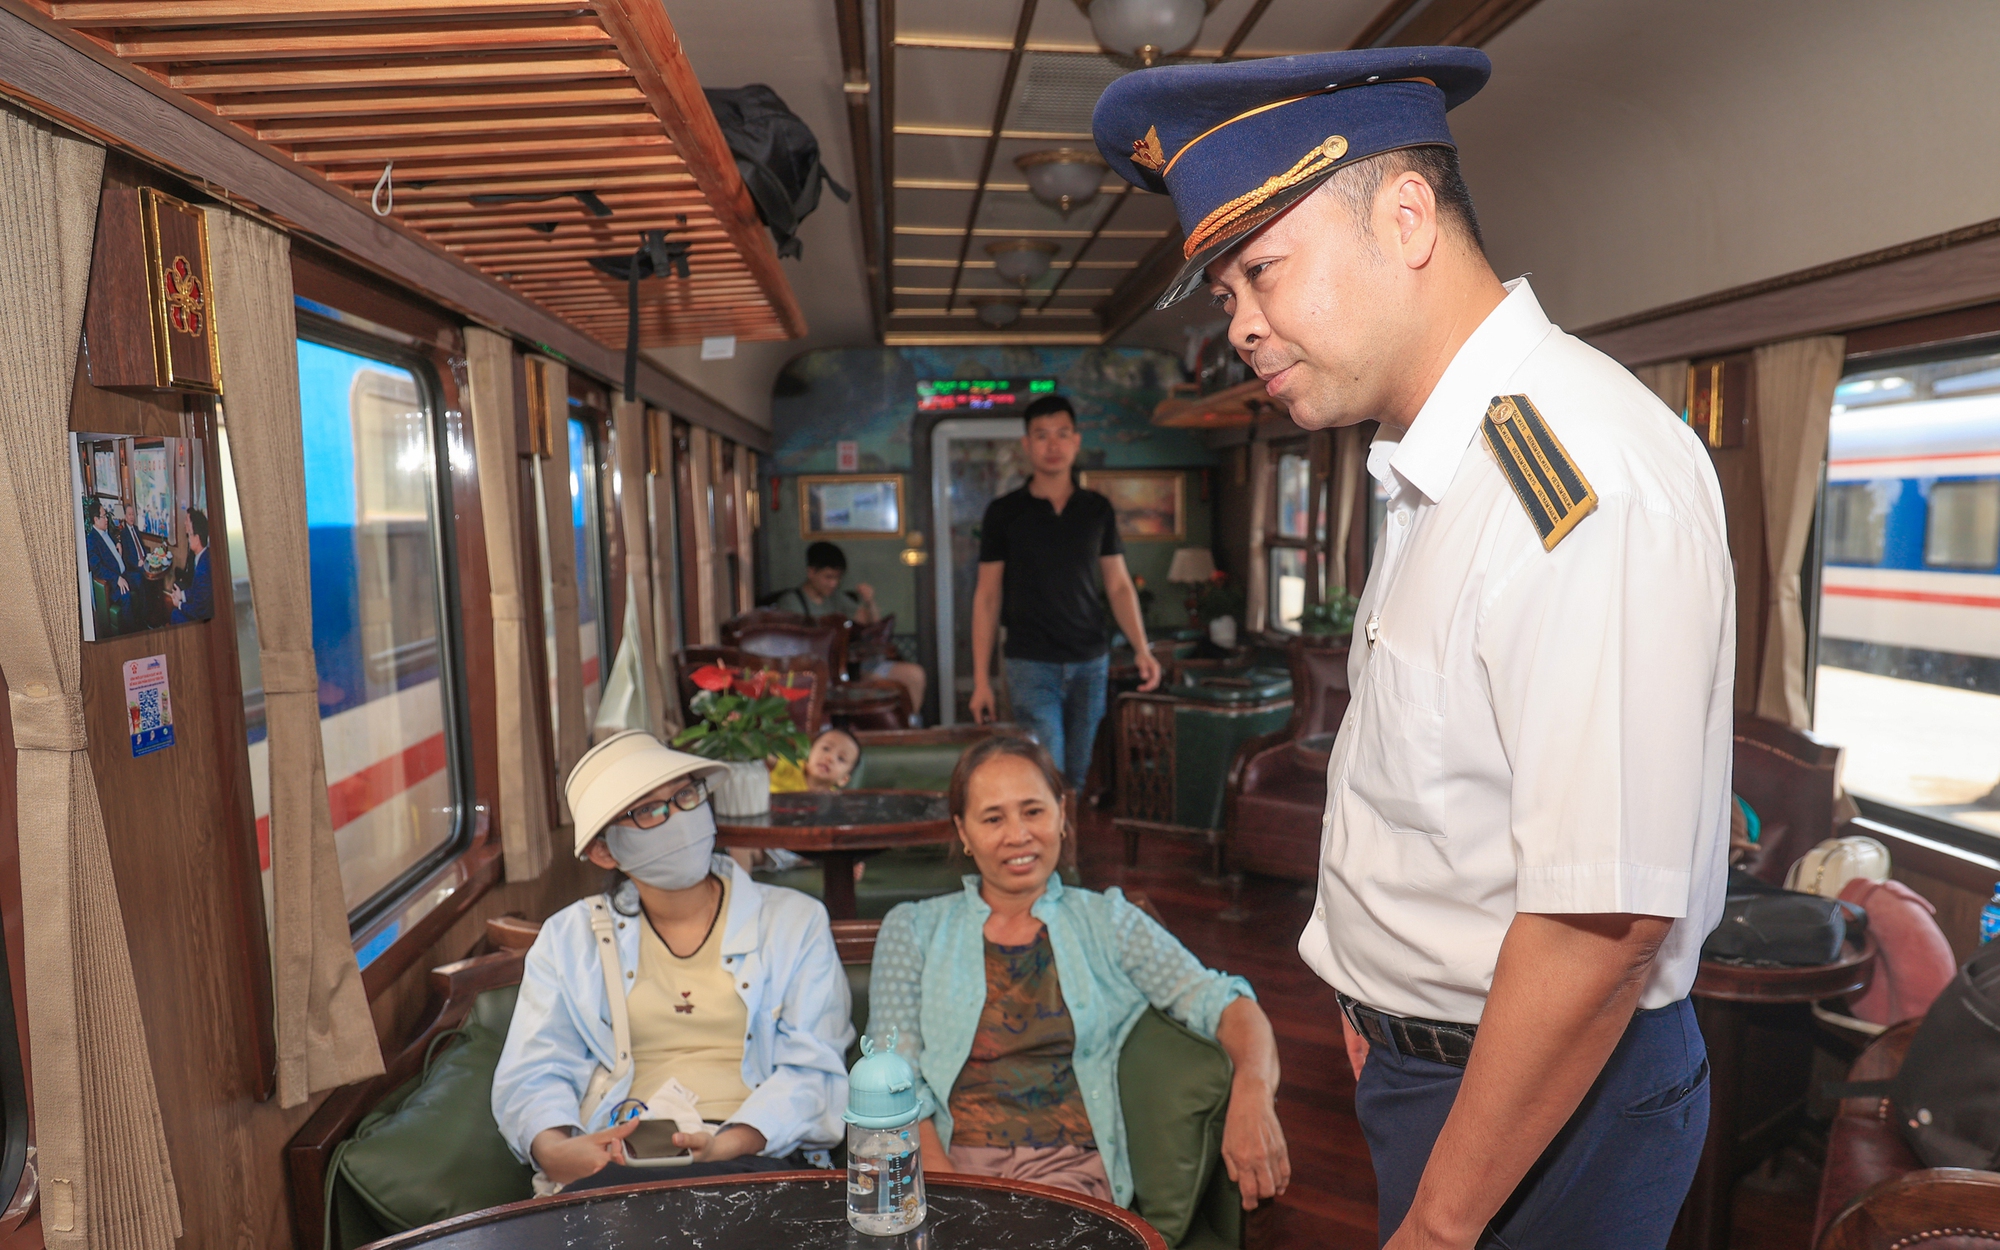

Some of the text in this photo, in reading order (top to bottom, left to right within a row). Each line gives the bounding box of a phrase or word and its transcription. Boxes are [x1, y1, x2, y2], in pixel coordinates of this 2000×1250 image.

[1511, 446, 1524, 465] VIETNAM
[1521, 462, 1537, 486] RAILWAYS
[1537, 488, 1550, 508] VIETNAM
[1526, 433, 1539, 452] VIETNAM
[1535, 449, 1551, 473] RAILWAYS
[1551, 475, 1563, 494] VIETNAM
